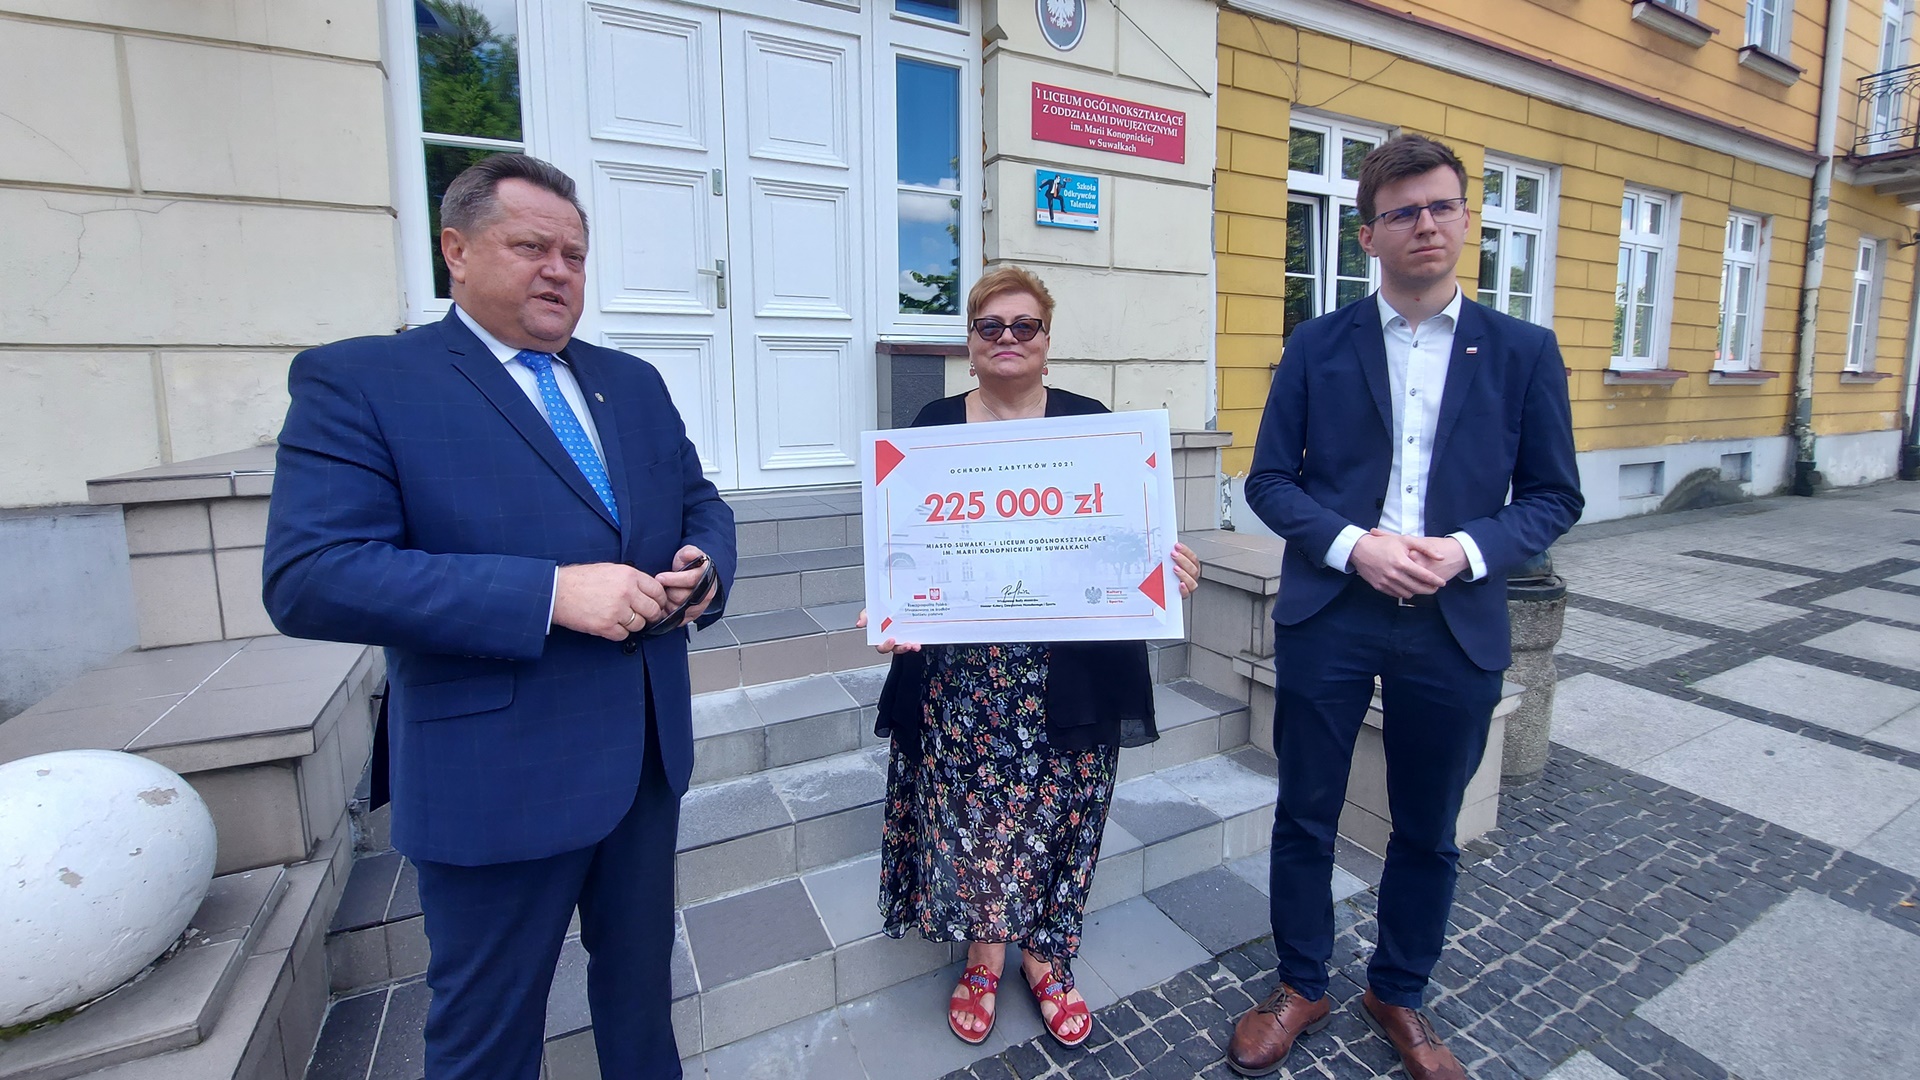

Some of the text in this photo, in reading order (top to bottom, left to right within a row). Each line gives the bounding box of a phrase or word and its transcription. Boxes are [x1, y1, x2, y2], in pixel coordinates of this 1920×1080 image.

[1043, 90, 1082, 107] LICEUM
[1084, 98, 1183, 127] OGÓLNOKSZTAŁCĄCE
[1042, 104, 1178, 137] Z ODDZIAŁAMI DWUJĘZYCZNYMI
[1070, 121, 1154, 146] im. Marii Konopnickiej
[1098, 138, 1137, 153] Suwałkach
[1076, 182, 1096, 191] Szkoła
[1063, 189, 1096, 200] Odkrywców
[1070, 200, 1096, 209] Talentów
[950, 466, 993, 475] OCHRONA
[998, 462, 1047, 471] ZABYTKÓW
[924, 483, 1104, 522] 225 000 zł
[1028, 535, 1107, 545] OGÓLNOKSZTAŁCĄCE
[979, 546, 1033, 554] KONOPNICKIEJ
